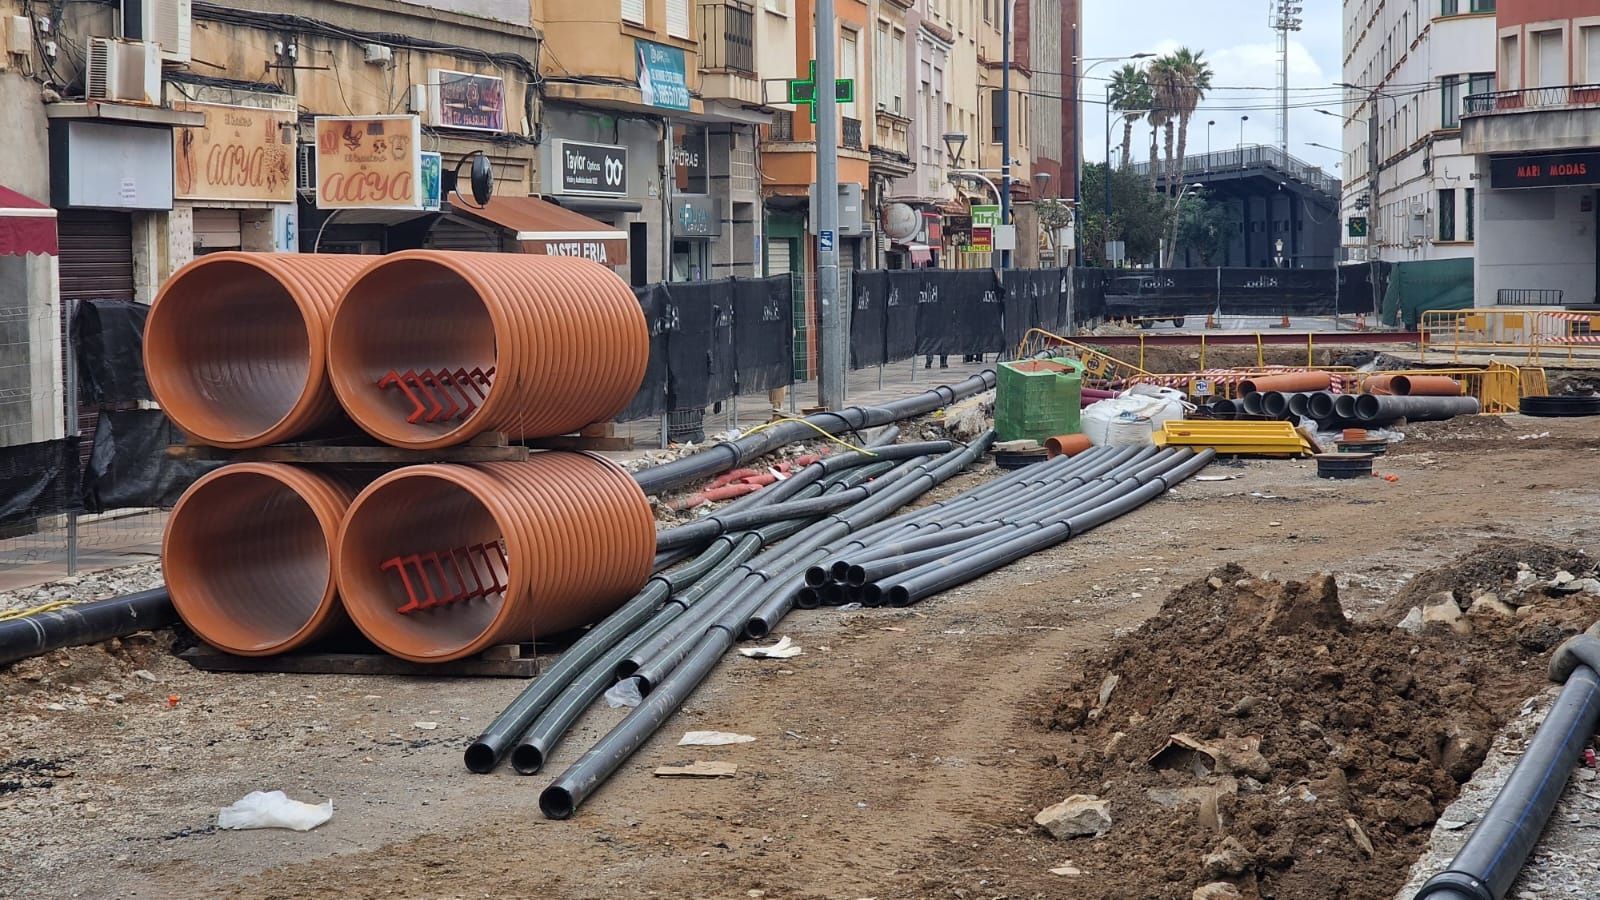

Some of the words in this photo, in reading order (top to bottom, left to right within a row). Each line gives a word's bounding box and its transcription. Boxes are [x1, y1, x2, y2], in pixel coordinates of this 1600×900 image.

[566, 149, 586, 175] Taylor
[675, 152, 699, 168] HORAS
[1517, 165, 1541, 177] MARI
[1550, 163, 1586, 177] MODAS
